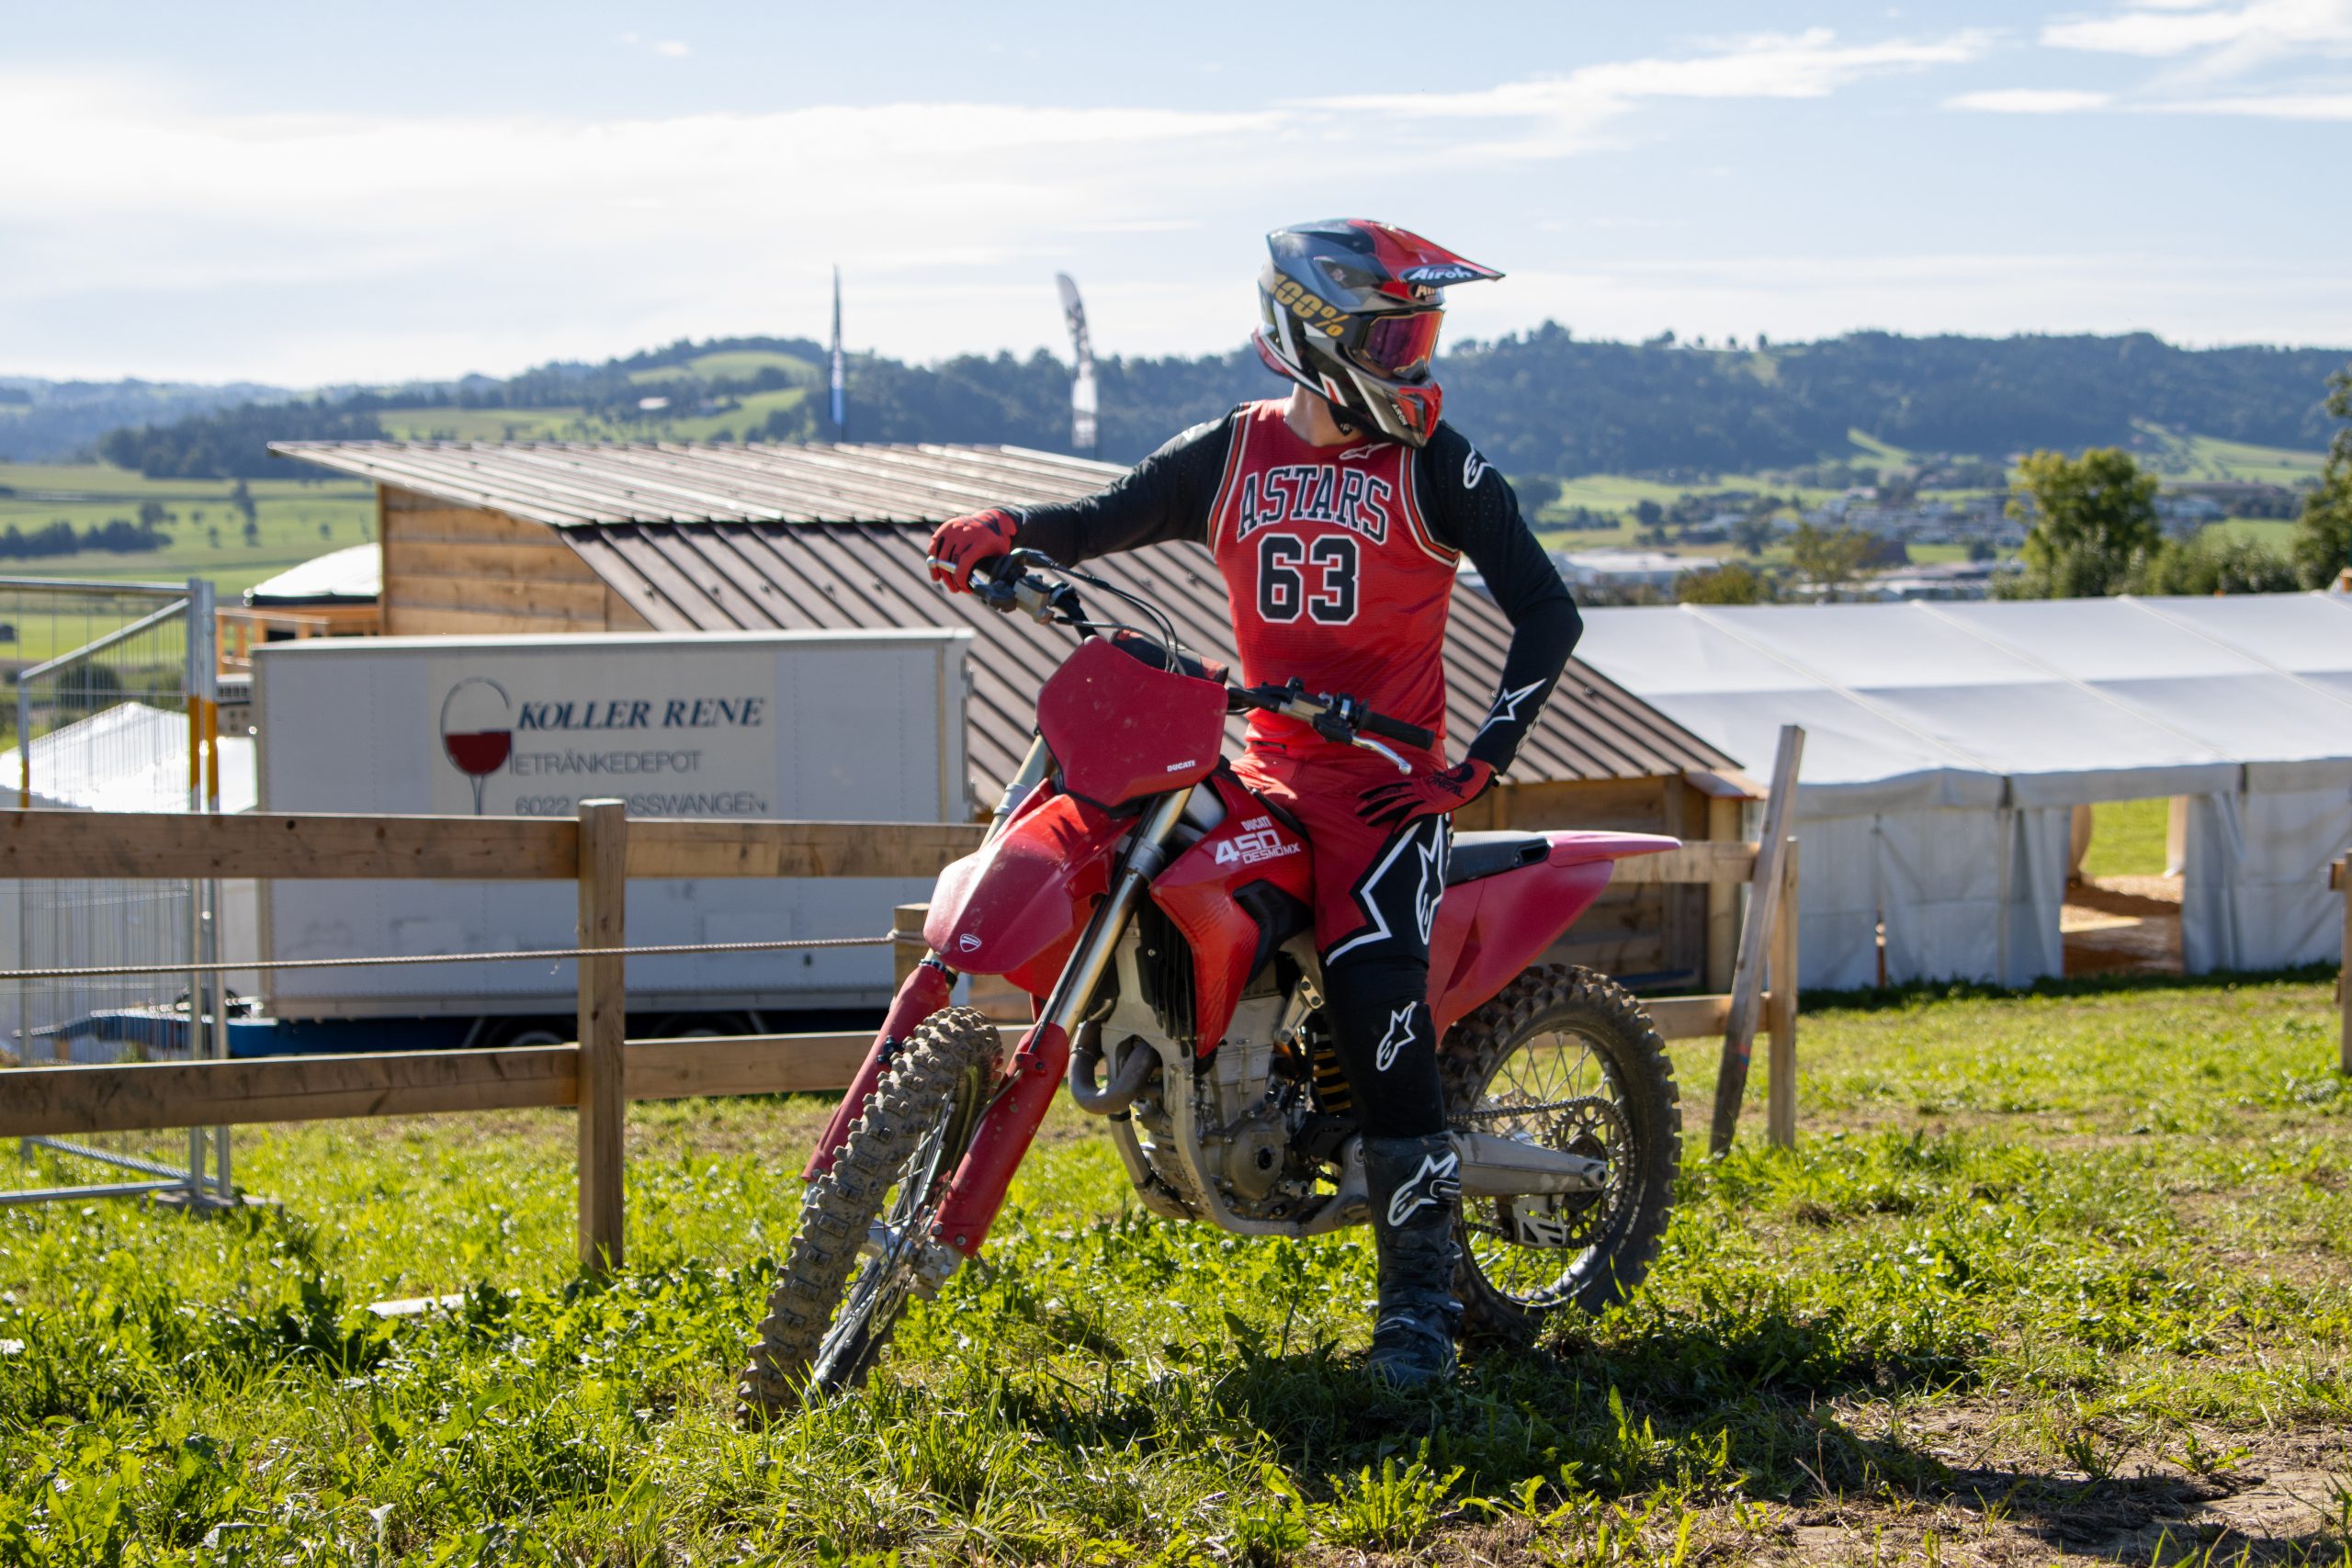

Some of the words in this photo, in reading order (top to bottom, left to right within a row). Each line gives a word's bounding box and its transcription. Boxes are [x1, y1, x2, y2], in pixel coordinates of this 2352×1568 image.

[1408, 266, 1473, 280] Airoh
[1269, 274, 1351, 337] 100%
[1237, 465, 1392, 546] ASTARS
[1257, 533, 1361, 626] 63
[516, 699, 651, 731] KOLLER
[662, 696, 765, 727] RENE
[1167, 760, 1196, 773] DUCATI
[1240, 816, 1272, 831] DUCATI
[1215, 829, 1283, 864] 450
